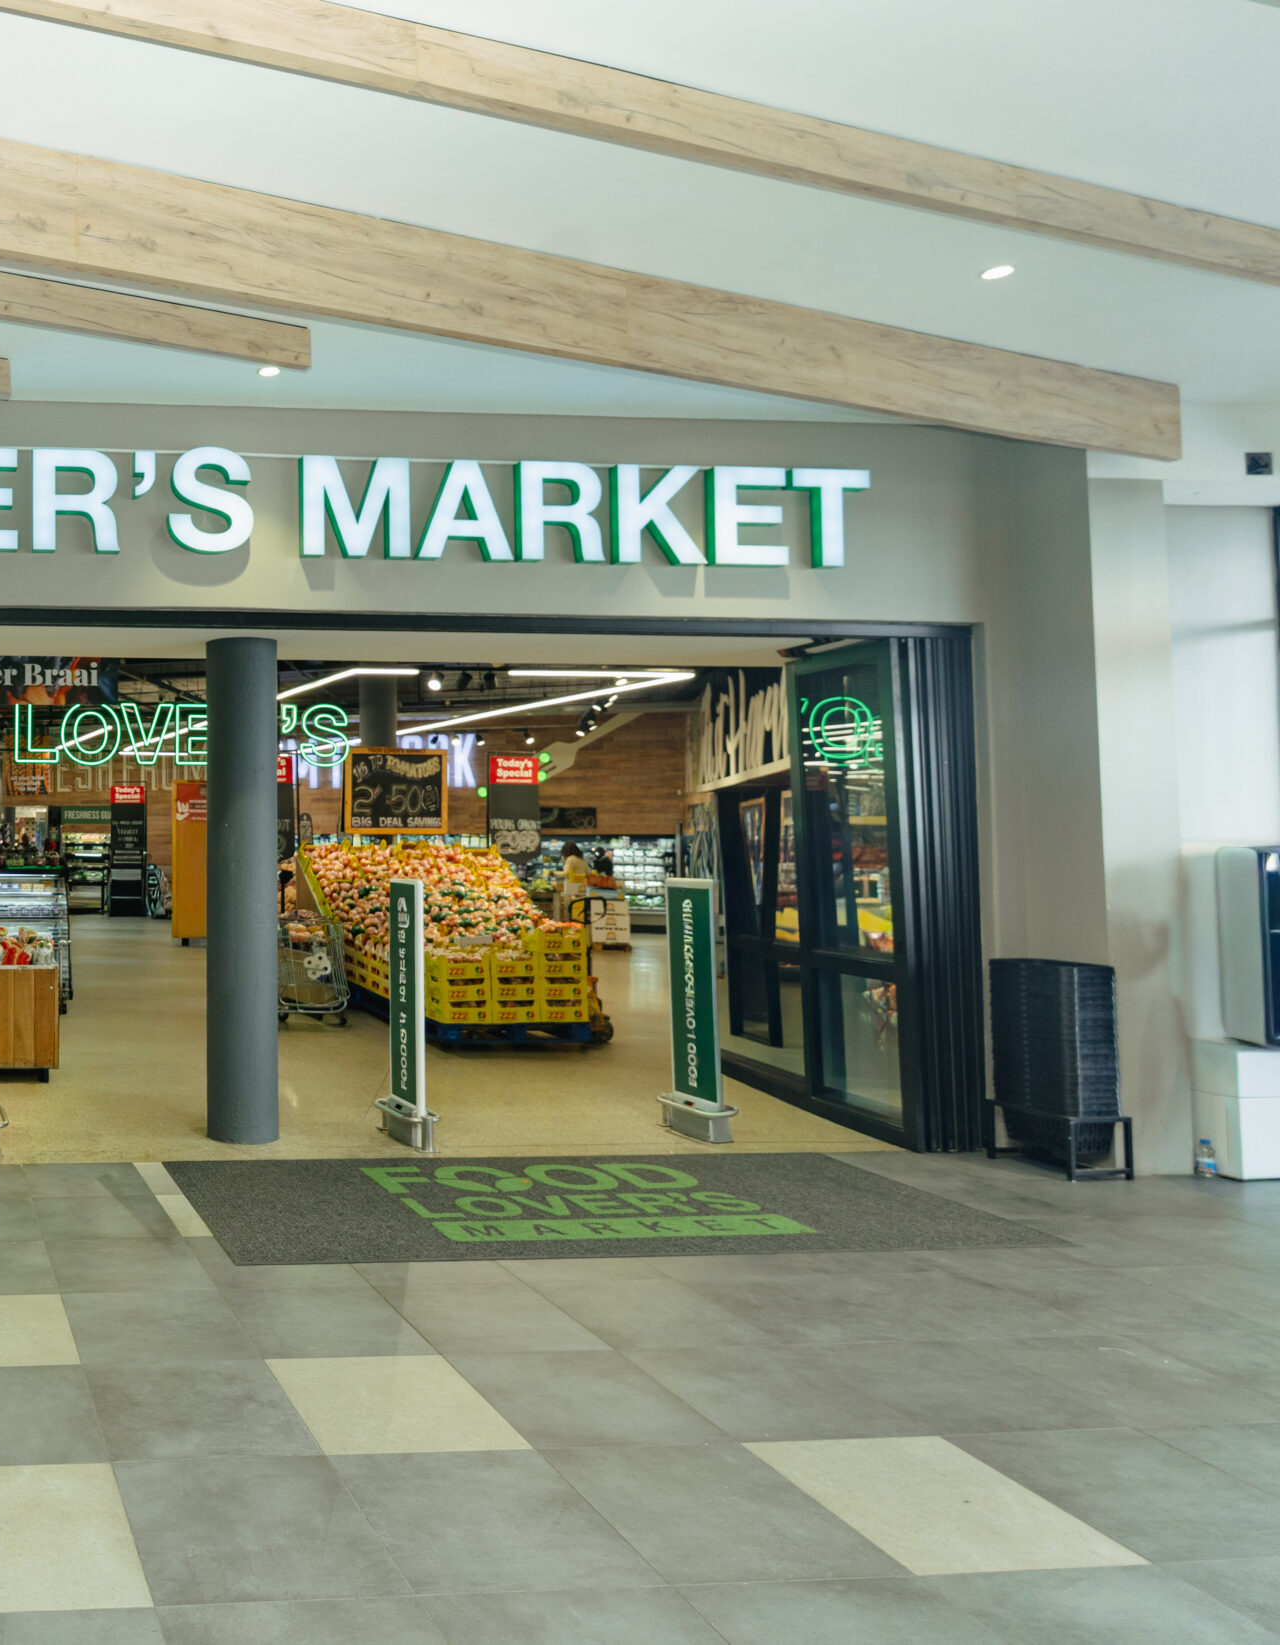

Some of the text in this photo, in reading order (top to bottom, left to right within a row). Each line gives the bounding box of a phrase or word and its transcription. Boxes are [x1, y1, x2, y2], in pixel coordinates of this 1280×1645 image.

[298, 454, 871, 569] MARKET
[23, 661, 101, 687] Braai
[14, 702, 351, 768] LOVE'S
[496, 758, 533, 768] Today's
[497, 768, 533, 779] Special
[64, 810, 99, 819] FRESHNESS
[352, 817, 442, 827] BIG DEAL SAVINGS
[359, 1163, 700, 1194] FOOD
[399, 1191, 762, 1220] LOVER'S
[459, 1217, 783, 1239] MARKET
